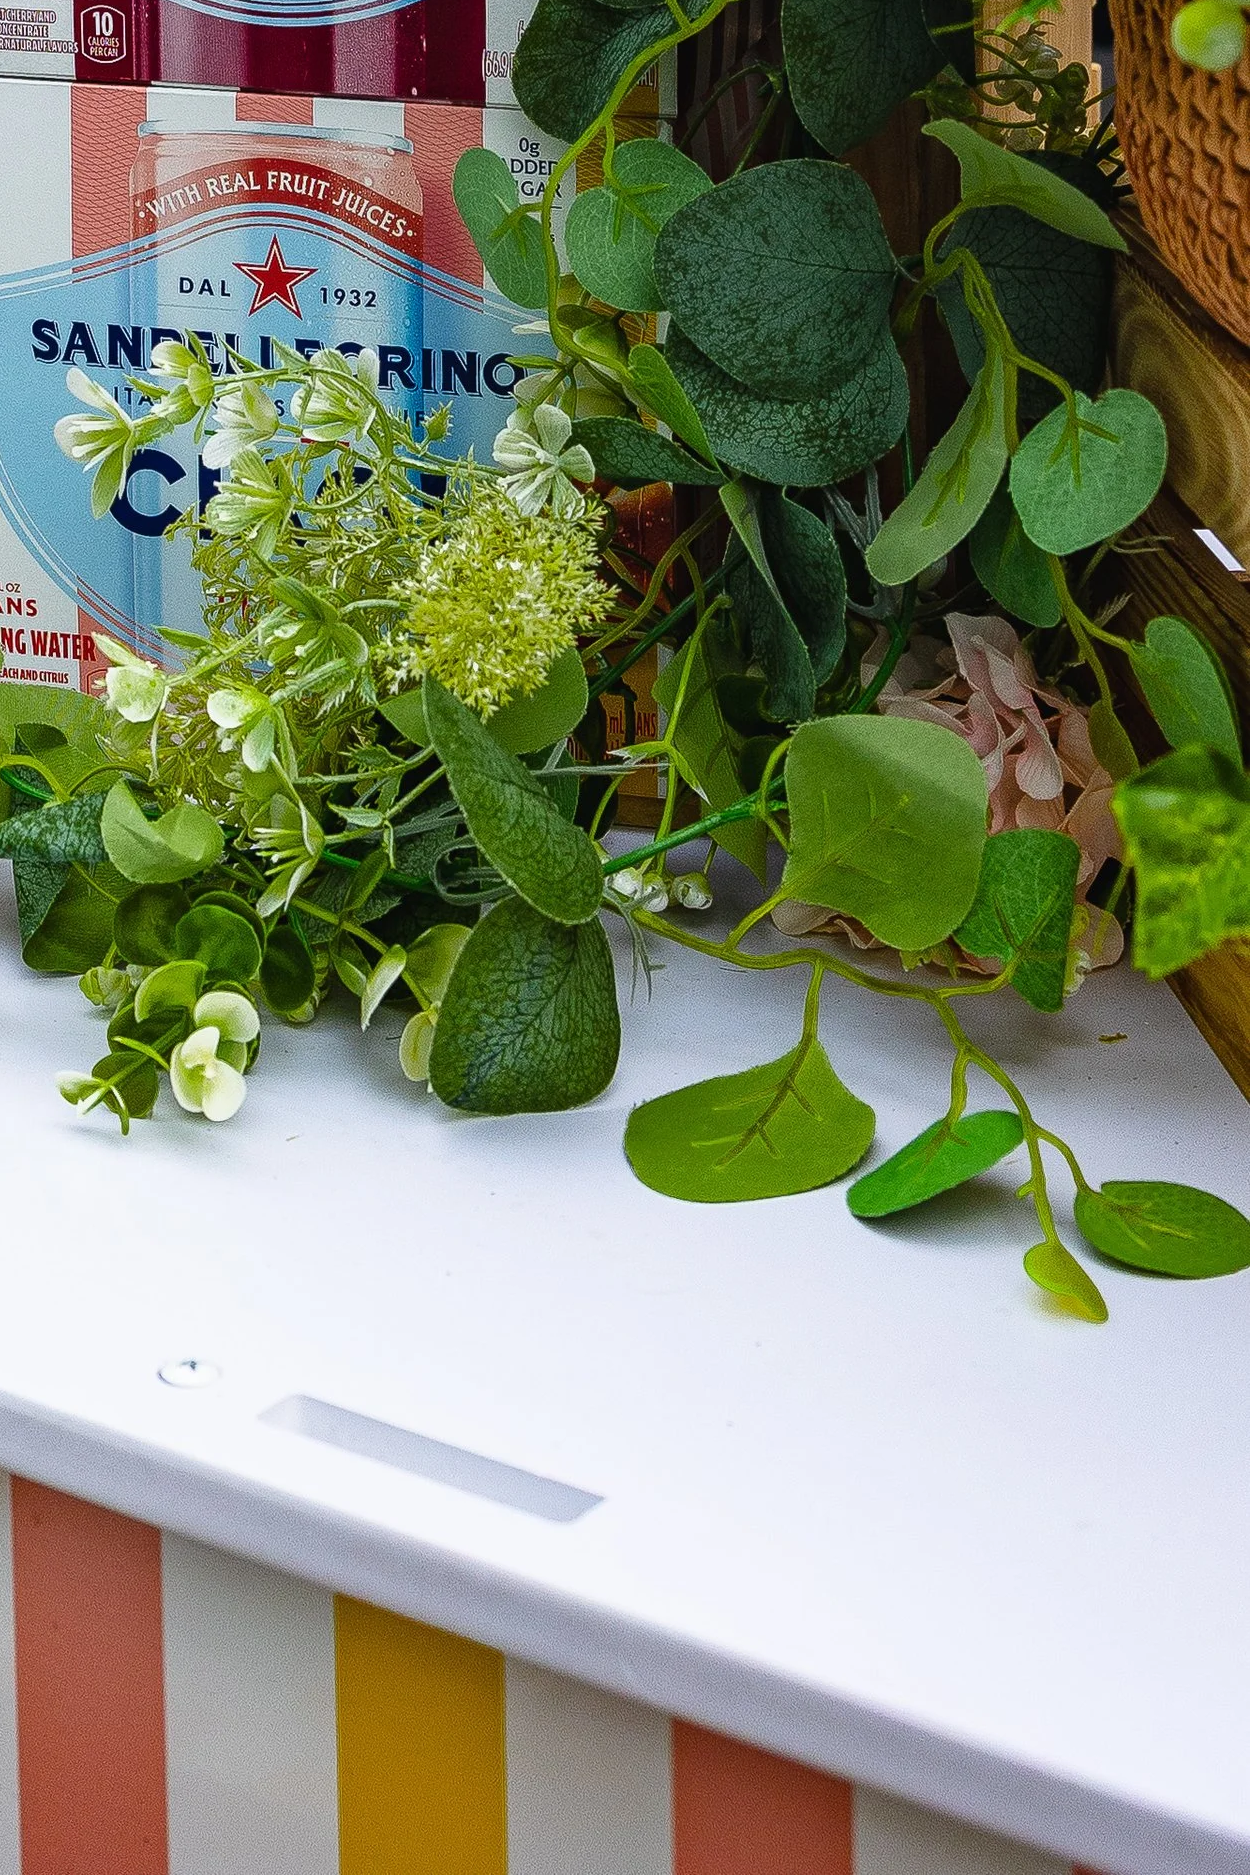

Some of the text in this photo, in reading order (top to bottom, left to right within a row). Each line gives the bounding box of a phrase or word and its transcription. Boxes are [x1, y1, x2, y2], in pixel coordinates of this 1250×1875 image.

[6, 8, 36, 22] CHERRY
[37, 10, 57, 23] AND
[93, 11, 113, 36] 10
[4, 38, 42, 51] NATURAL
[43, 40, 78, 53] FLAVORS
[88, 36, 120, 47] CALORIES
[90, 46, 118, 57] PER CAN
[519, 137, 541, 158] 0g
[502, 157, 558, 176] DDE
[146, 171, 406, 238] WITH REAL FRUIT JUICES
[179, 277, 377, 308] DAL 1932
[5, 582, 21, 593] OZ
[30, 629, 96, 662] WATER
[20, 669, 38, 681] AND
[39, 671, 69, 684] CITRUS
